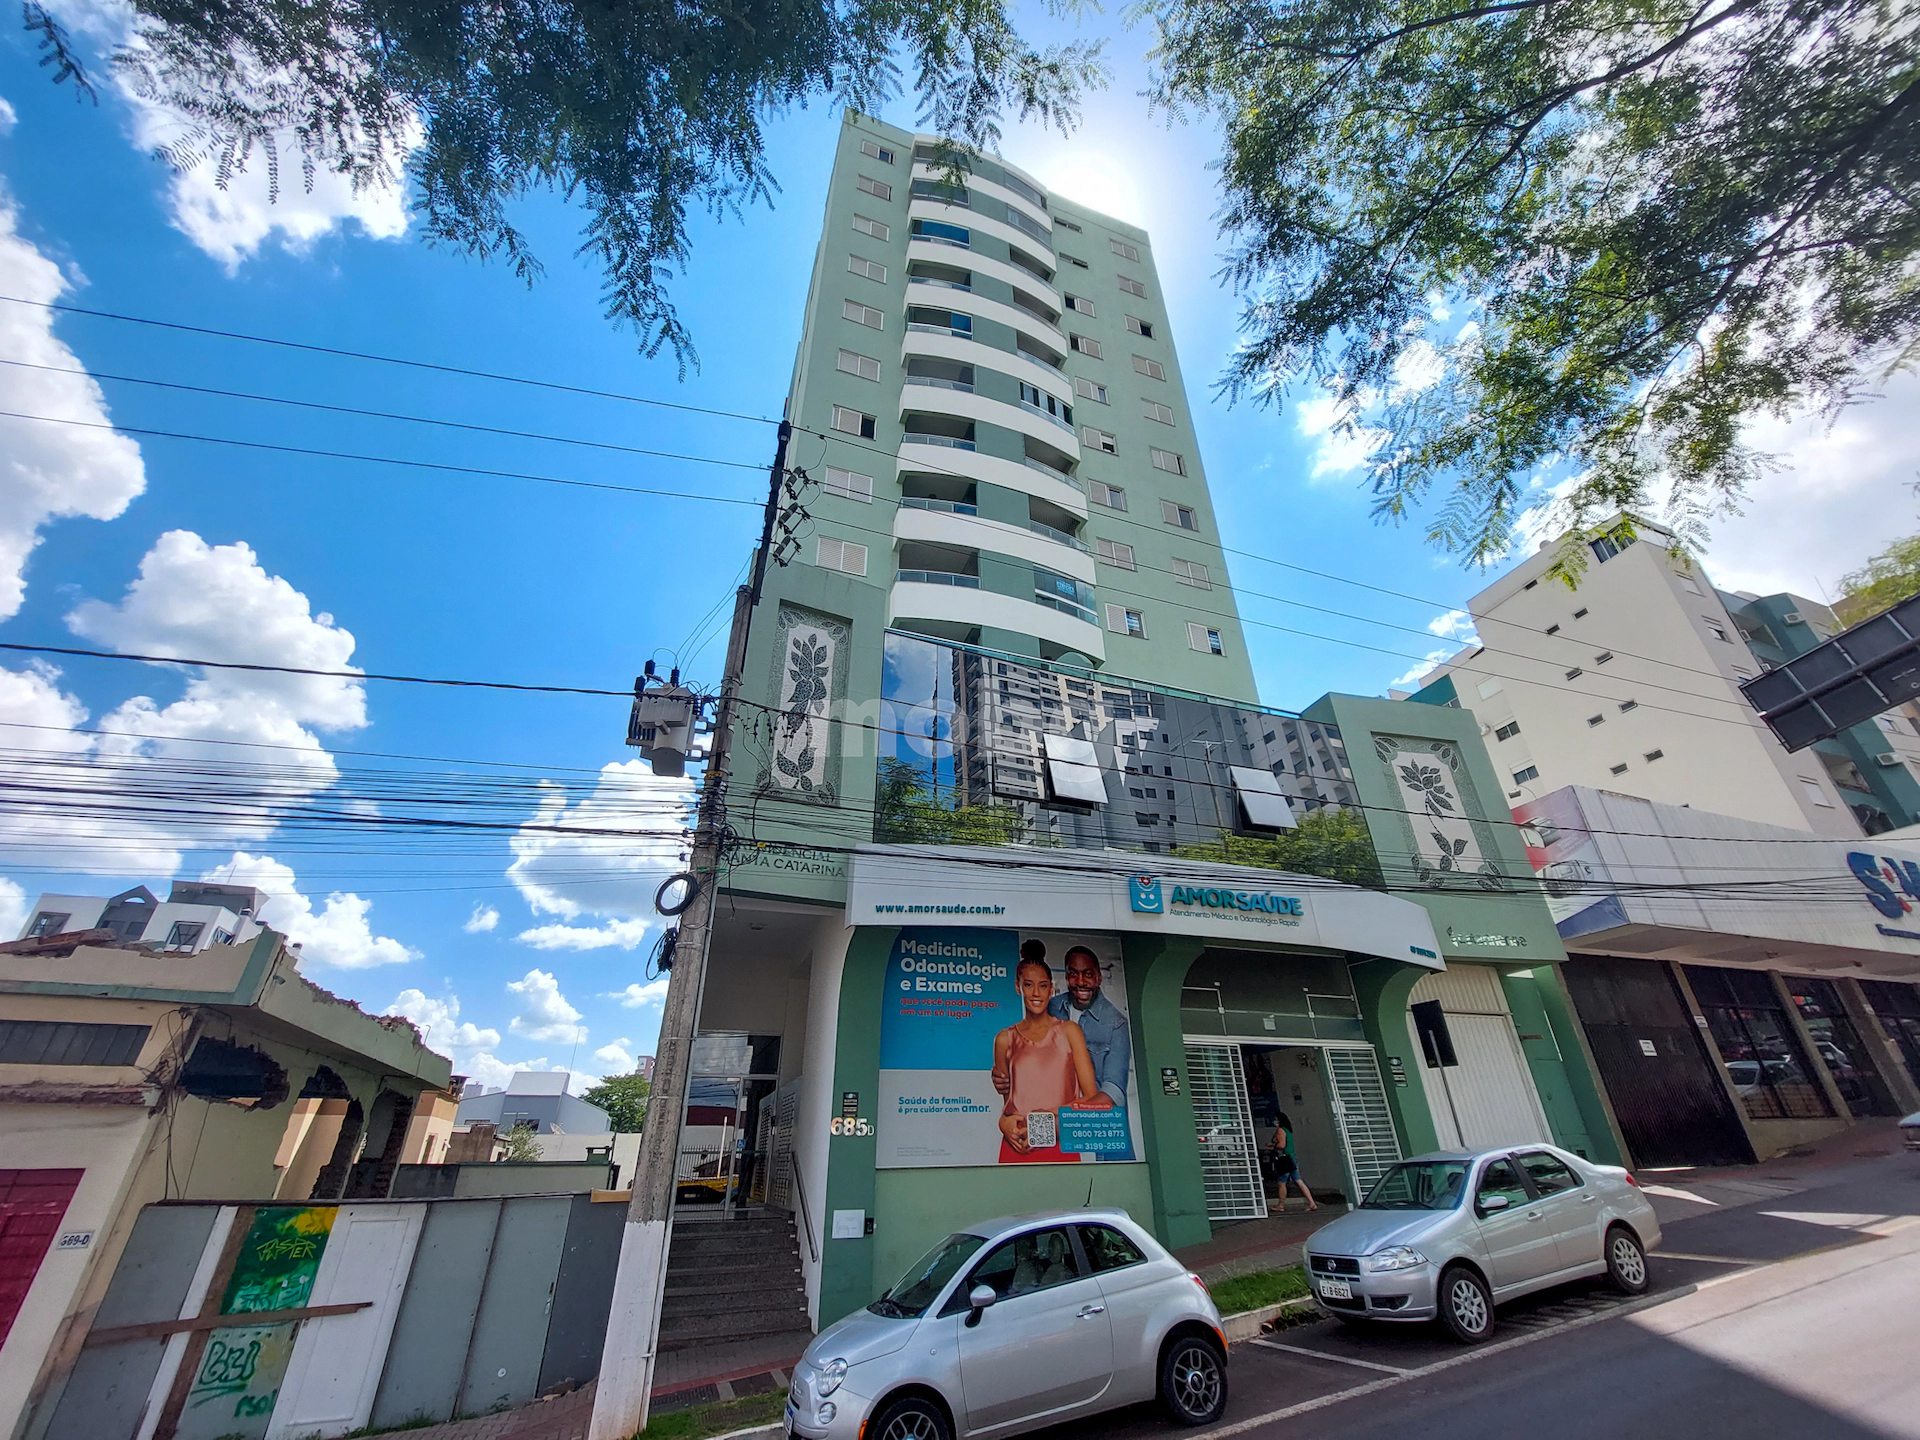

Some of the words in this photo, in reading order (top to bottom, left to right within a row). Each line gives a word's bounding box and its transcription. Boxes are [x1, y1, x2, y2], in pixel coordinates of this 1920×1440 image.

[773, 858, 846, 878] CATARINA
[1171, 885, 1304, 916] AMORSAÚDE
[875, 904, 1006, 914] www.amorsaude.com.br
[1169, 909, 1211, 919] Atendimento
[901, 939, 983, 960] Medicina,
[900, 957, 1007, 981] Odontologia
[900, 979, 912, 991] e
[915, 976, 983, 994] Exames
[900, 998, 919, 1006] que
[921, 997, 943, 1005] você
[945, 998, 969, 1007] pode
[934, 1008, 945, 1016] só
[898, 1096, 927, 1105] Saúde
[929, 1096, 940, 1105] da
[904, 1107, 918, 1115] pra
[961, 1105, 991, 1113] amor.
[1072, 1130, 1092, 1138] 0800
[1093, 1130, 1107, 1138] 723
[1084, 1141, 1126, 1150] 3199-2550
